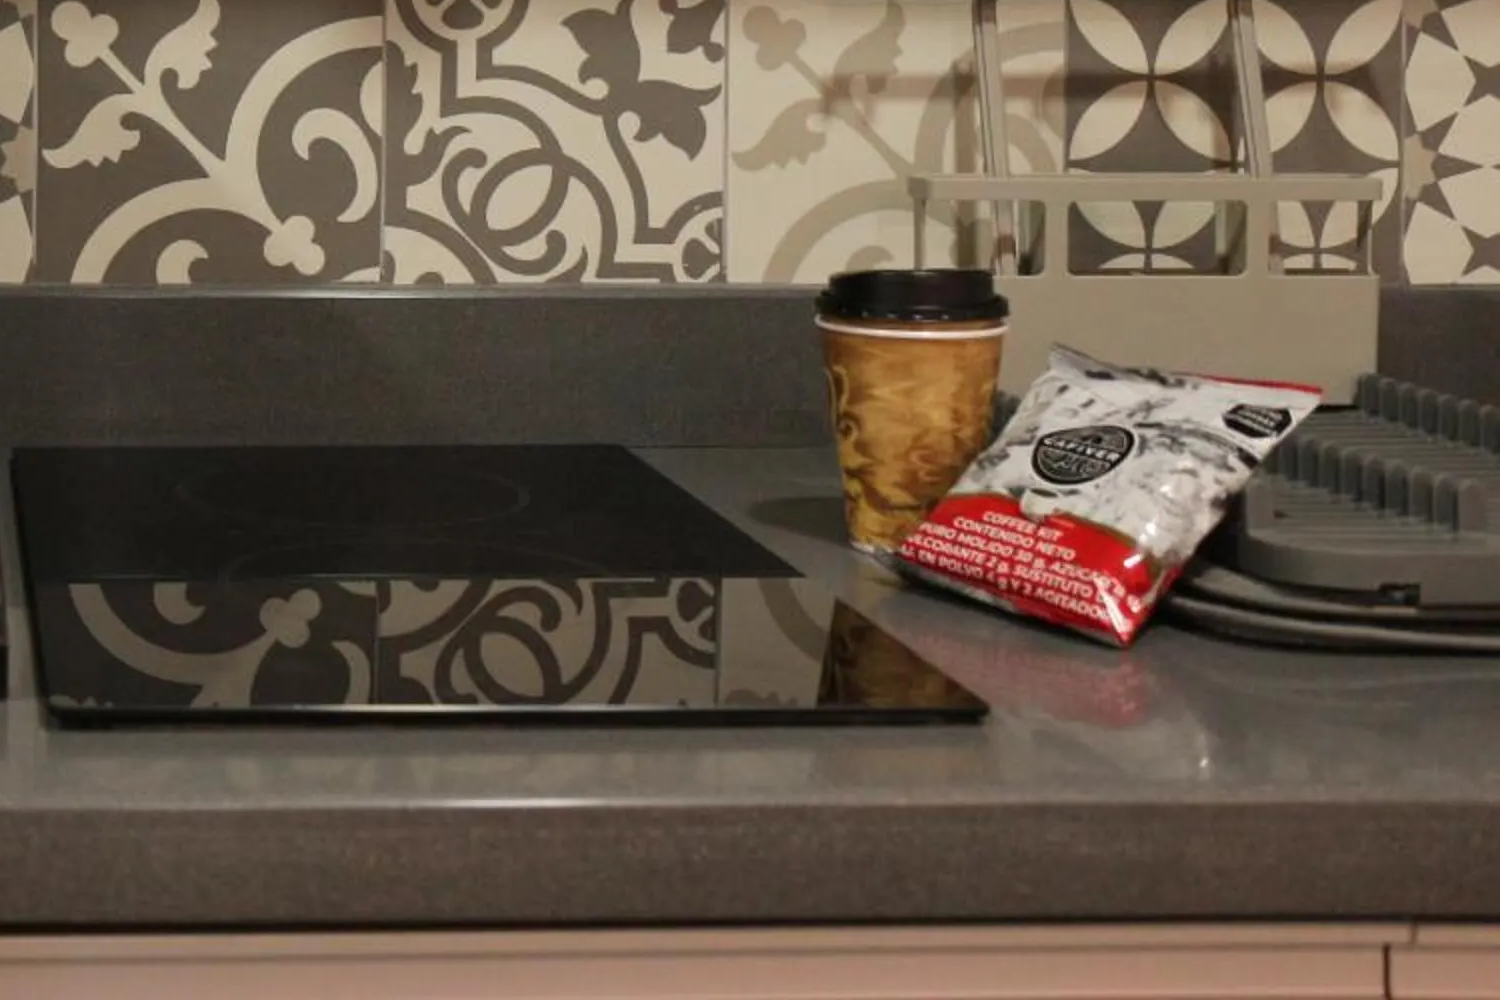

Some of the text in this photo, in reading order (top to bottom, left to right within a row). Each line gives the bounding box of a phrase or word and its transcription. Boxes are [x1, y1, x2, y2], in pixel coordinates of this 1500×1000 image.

[918, 521, 957, 540] PURO
[956, 532, 1014, 558] MOLIDO
[953, 516, 1077, 561] CONTENIDO NETO
[982, 511, 1064, 542] COFFEE KIT
[937, 554, 985, 579] POLVO
[1013, 563, 1094, 598] SUSTITUTO
